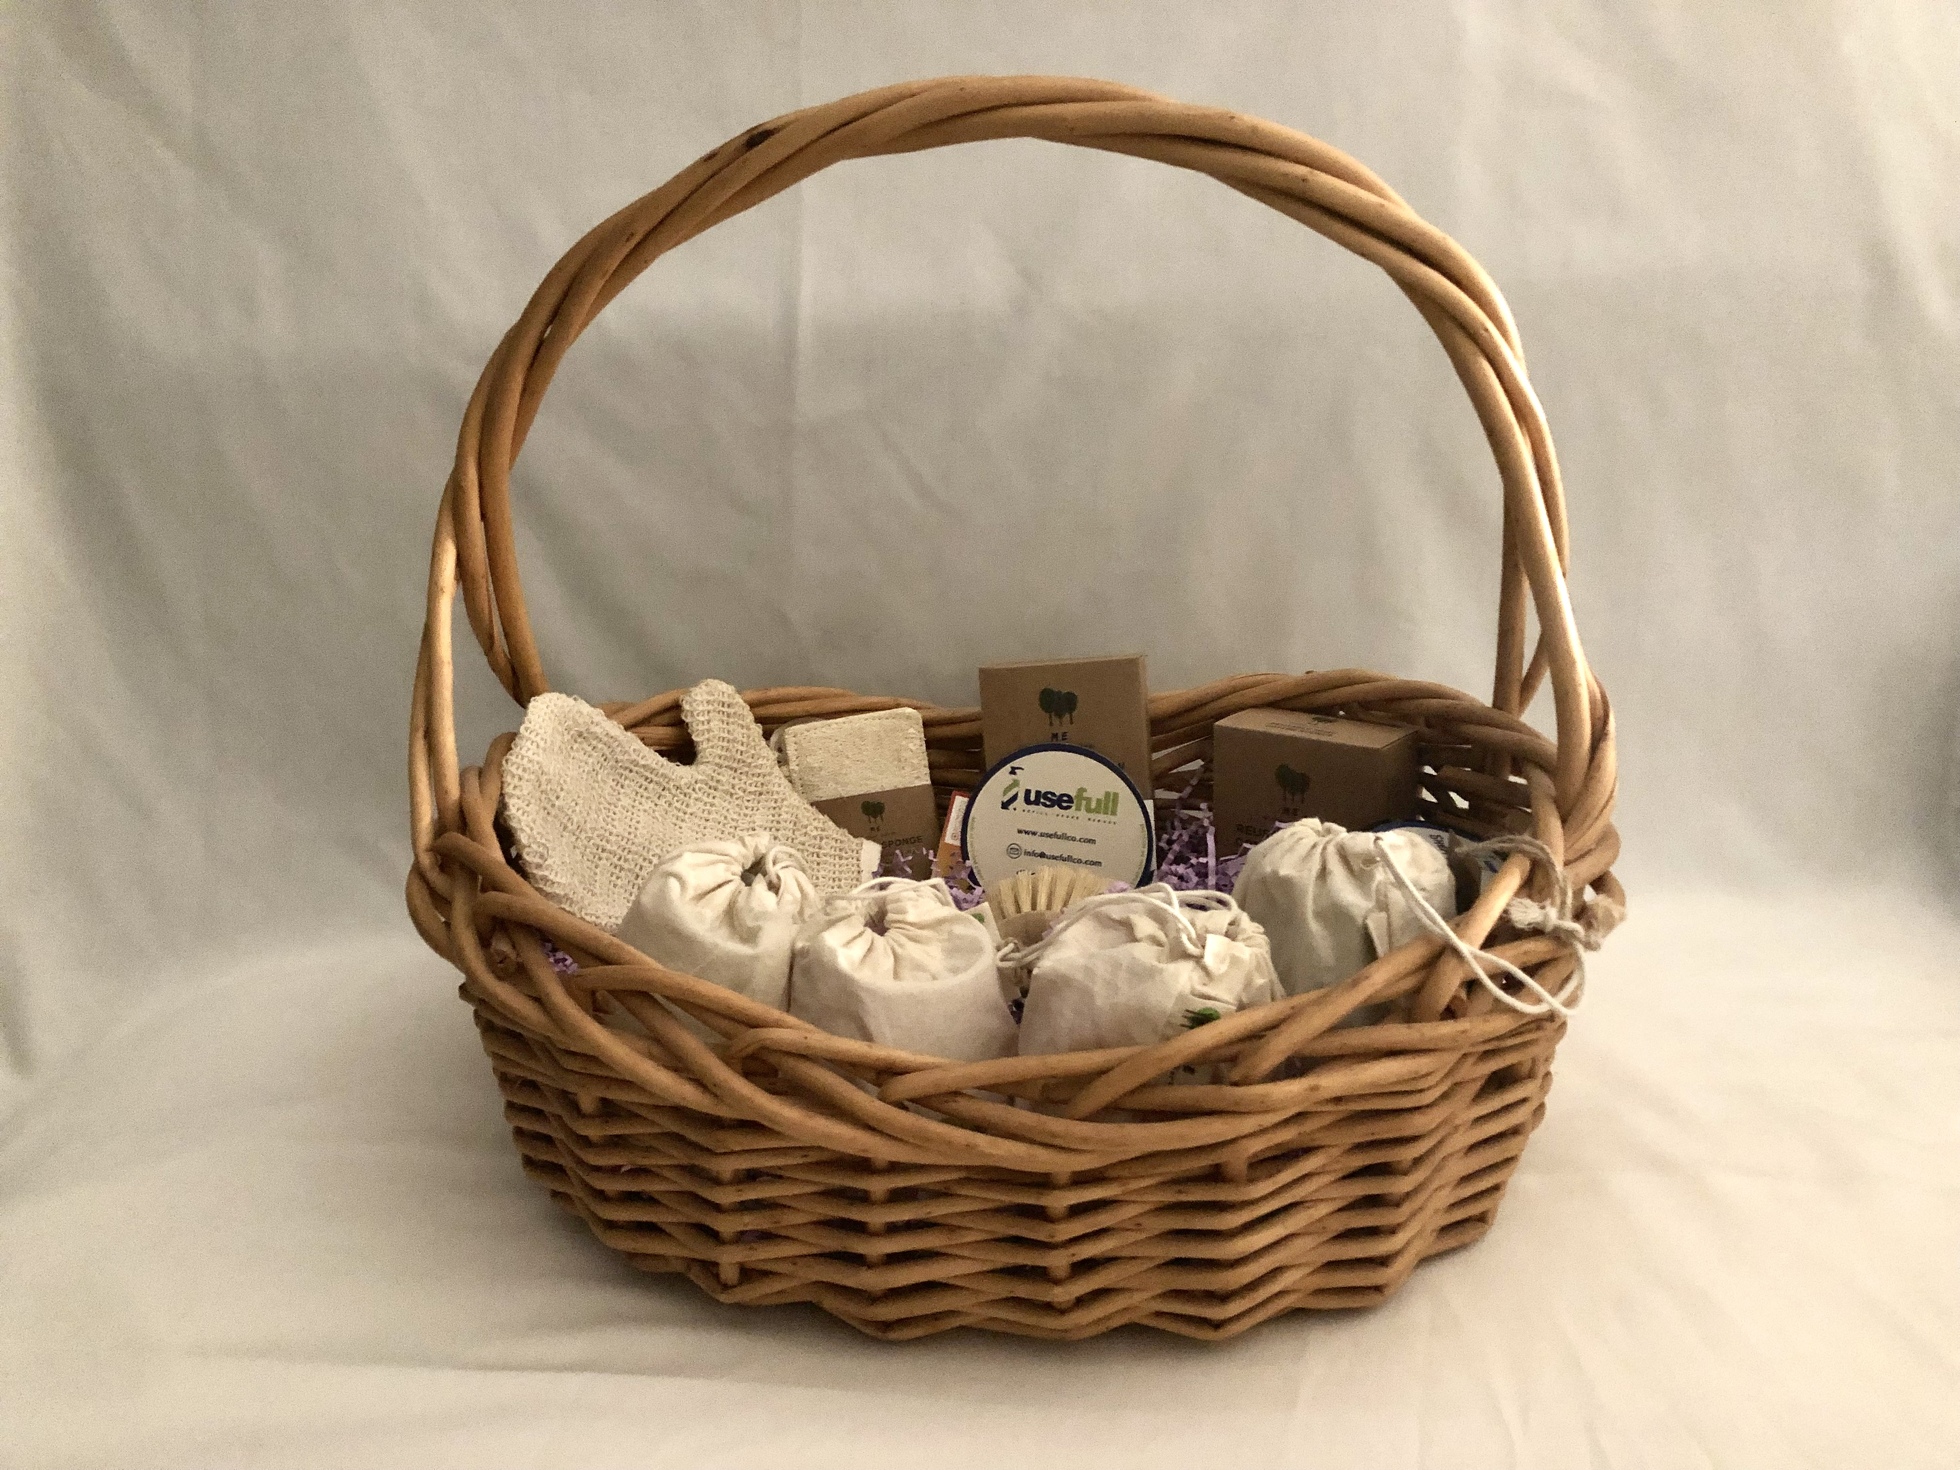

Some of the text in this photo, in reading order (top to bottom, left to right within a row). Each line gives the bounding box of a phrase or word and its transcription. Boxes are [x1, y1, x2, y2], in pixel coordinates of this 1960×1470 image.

[1023, 786, 1120, 816] usefull
[881, 835, 924, 849] SPONGE
[1016, 828, 1097, 845] www.usefullco.com
[1023, 848, 1103, 867] info@usefullco.com
